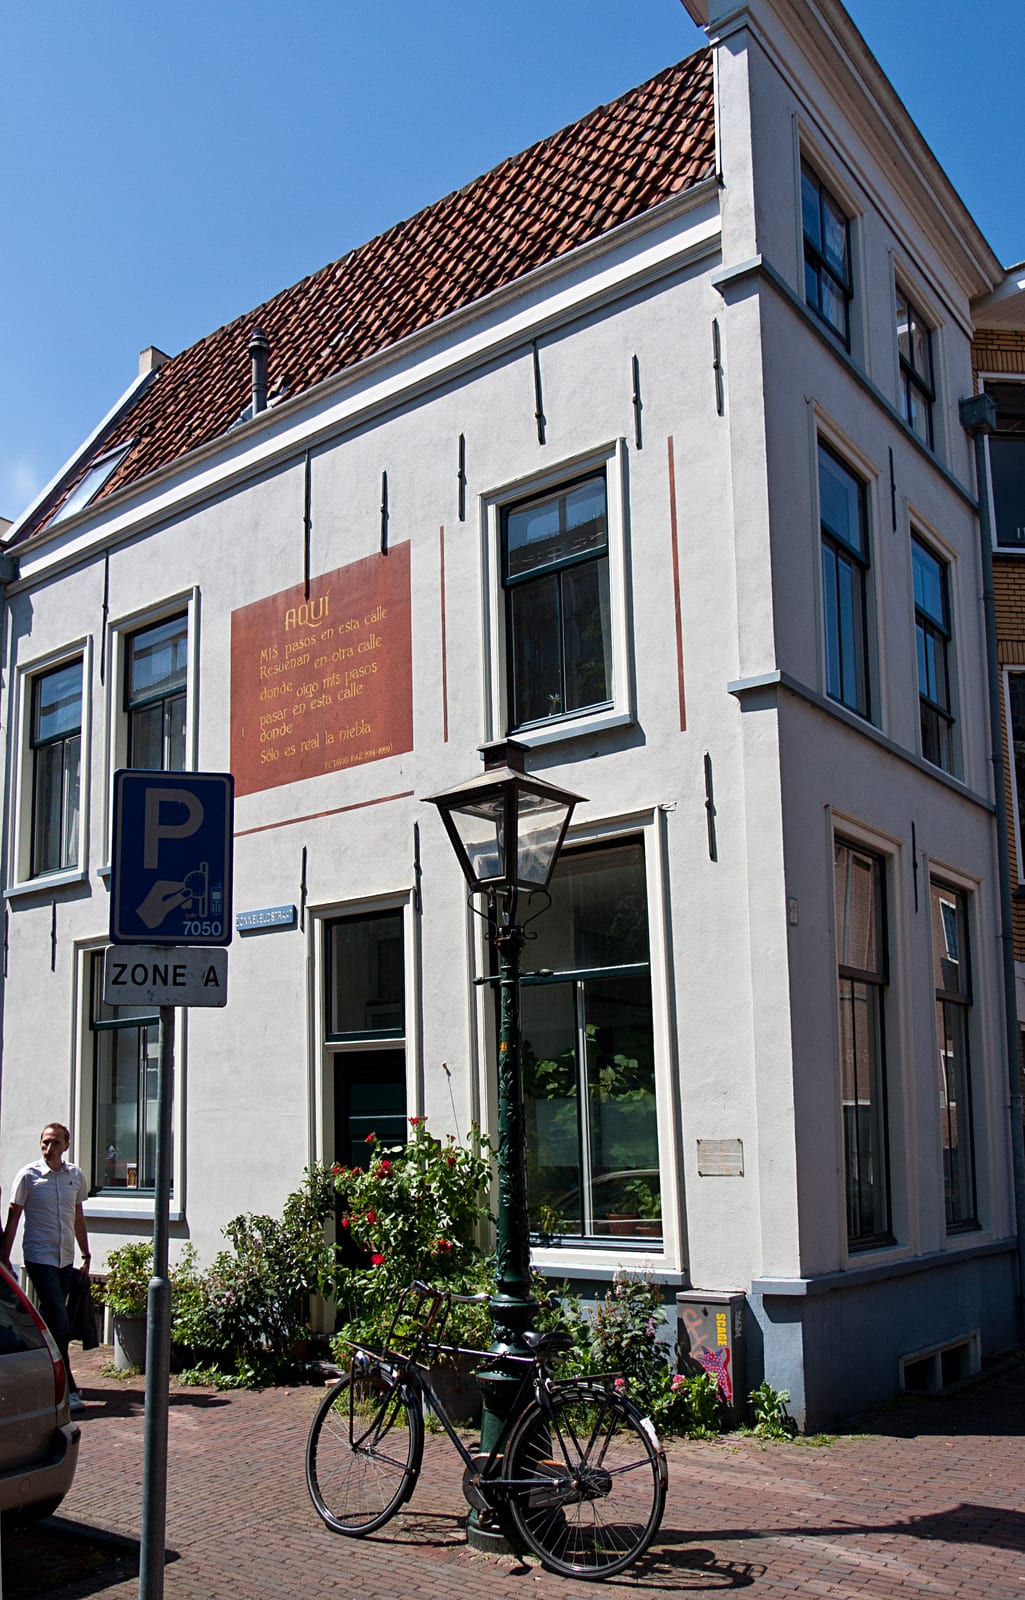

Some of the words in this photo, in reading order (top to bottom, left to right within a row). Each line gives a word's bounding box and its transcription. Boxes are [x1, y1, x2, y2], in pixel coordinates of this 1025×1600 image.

[284, 590, 330, 631] AQUÍ
[285, 633, 316, 659] pasos
[320, 628, 334, 641] en
[338, 618, 360, 635] esta
[364, 605, 388, 625] calle
[260, 653, 310, 679] Resuenan
[314, 656, 328, 669] en
[332, 647, 354, 662] otra
[357, 634, 382, 653] calle
[260, 681, 293, 701] donde
[296, 682, 319, 698] oigo
[323, 673, 341, 689] mis
[345, 662, 378, 686] pasos
[260, 708, 287, 730] pasar
[292, 701, 306, 716] en
[310, 693, 332, 710] esta
[337, 682, 363, 701] calle
[260, 722, 293, 742] donde
[260, 747, 280, 765] Sólo
[284, 743, 296, 757] es
[300, 732, 320, 753] real
[325, 730, 335, 745] la
[339, 719, 371, 741] niebla
[350, 752, 364, 763] PAZ
[143, 787, 204, 869] P
[182, 921, 222, 936] 7050
[112, 963, 187, 986] ZONE
[203, 966, 220, 987] A
